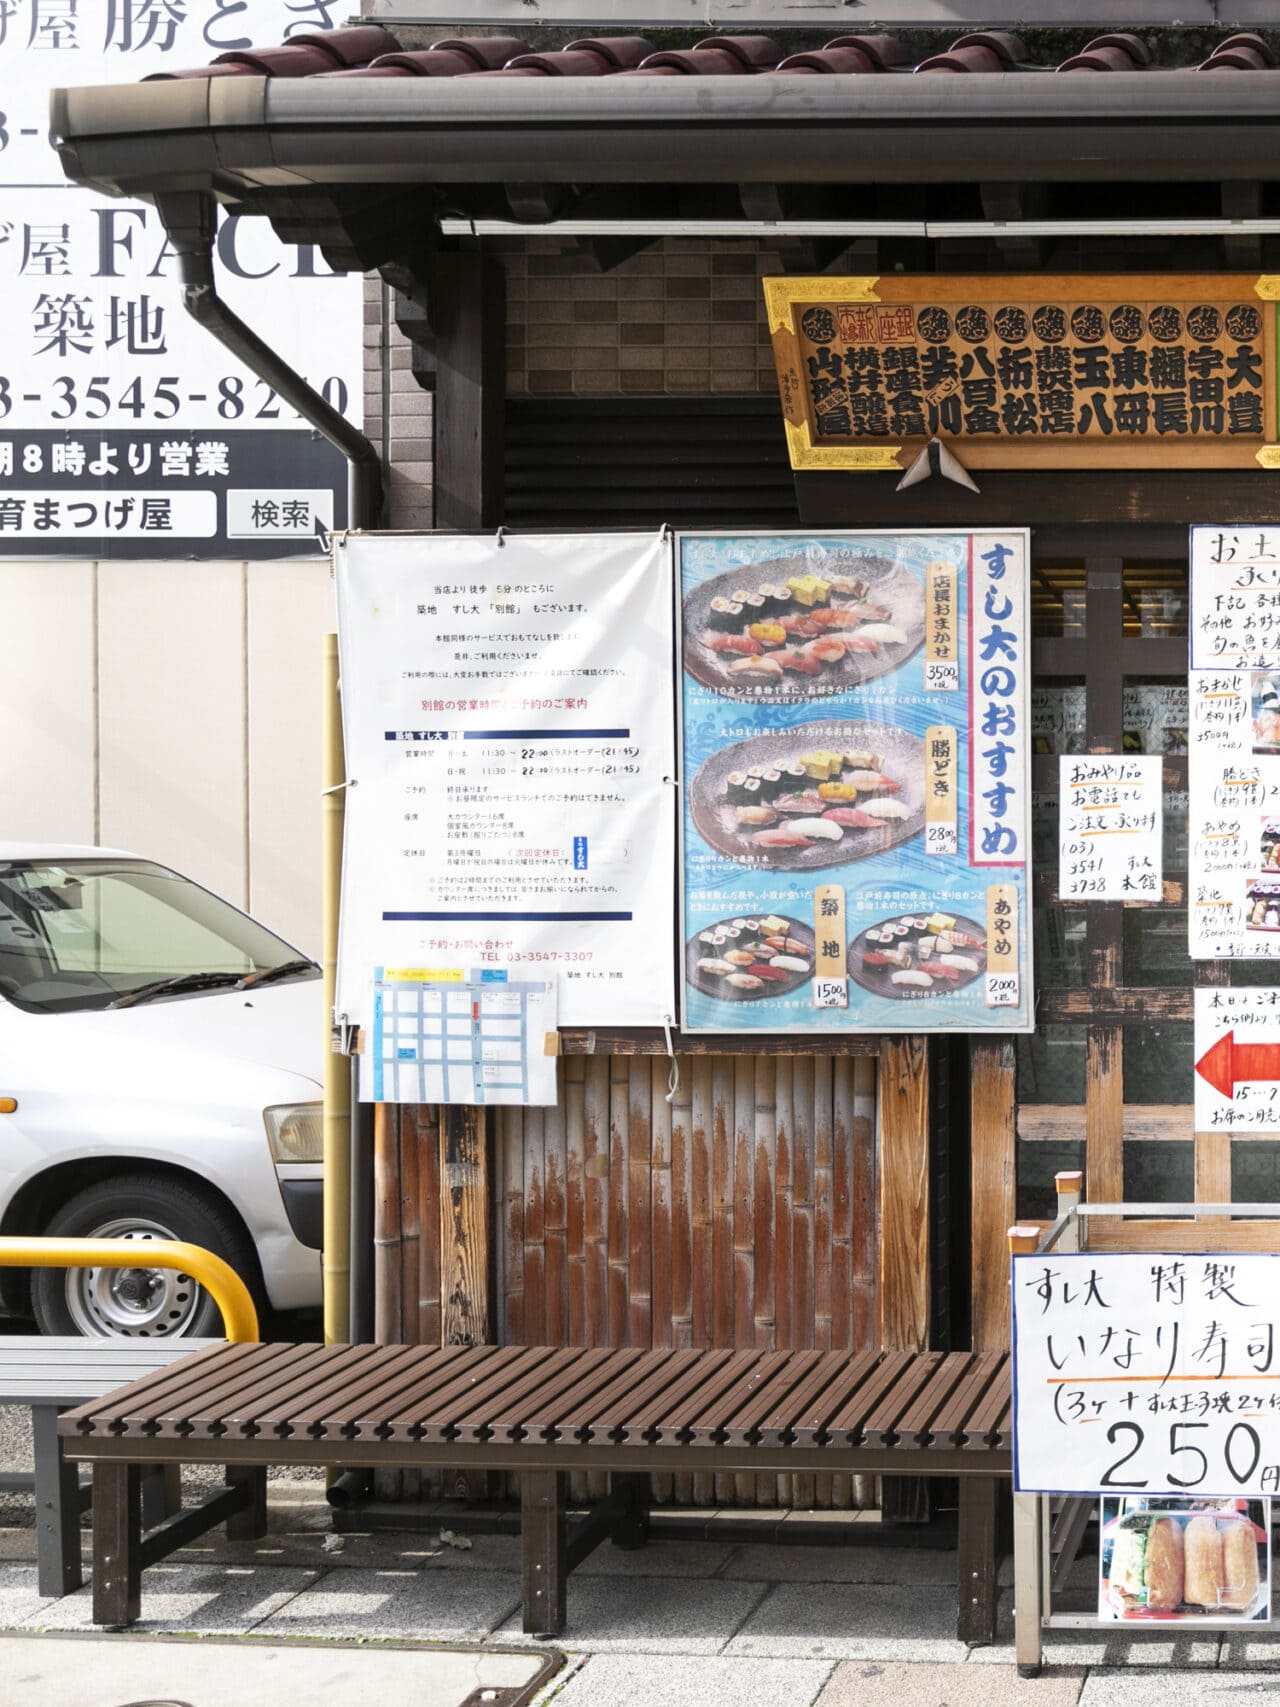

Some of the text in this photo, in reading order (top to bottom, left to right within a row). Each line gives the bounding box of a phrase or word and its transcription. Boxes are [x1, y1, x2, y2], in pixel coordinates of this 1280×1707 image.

[0, 219, 72, 278] 屋
[32, 293, 168, 357] 築地
[0, 376, 348, 419] -3545-820
[251, 499, 310, 529] 検索
[416, 604, 438, 615] 築地
[452, 604, 480, 615] すし大
[533, 603, 588, 614] もございます。
[932, 576, 952, 658] 店長おまかせ
[1214, 595, 1246, 611] 下記
[979, 543, 1018, 855] すし大のおすすめ
[1197, 675, 1243, 694] おまかせ
[930, 739, 951, 798] 勝どき
[821, 898, 840, 958] 築地
[993, 898, 1012, 956] あやめ
[480, 951, 593, 962] TEL 03-3547-3307
[1026, 1262, 1259, 1314] すし大 特製
[1047, 1320, 1274, 1388] いなり寿司
[1100, 1421, 1280, 1492] 250円
